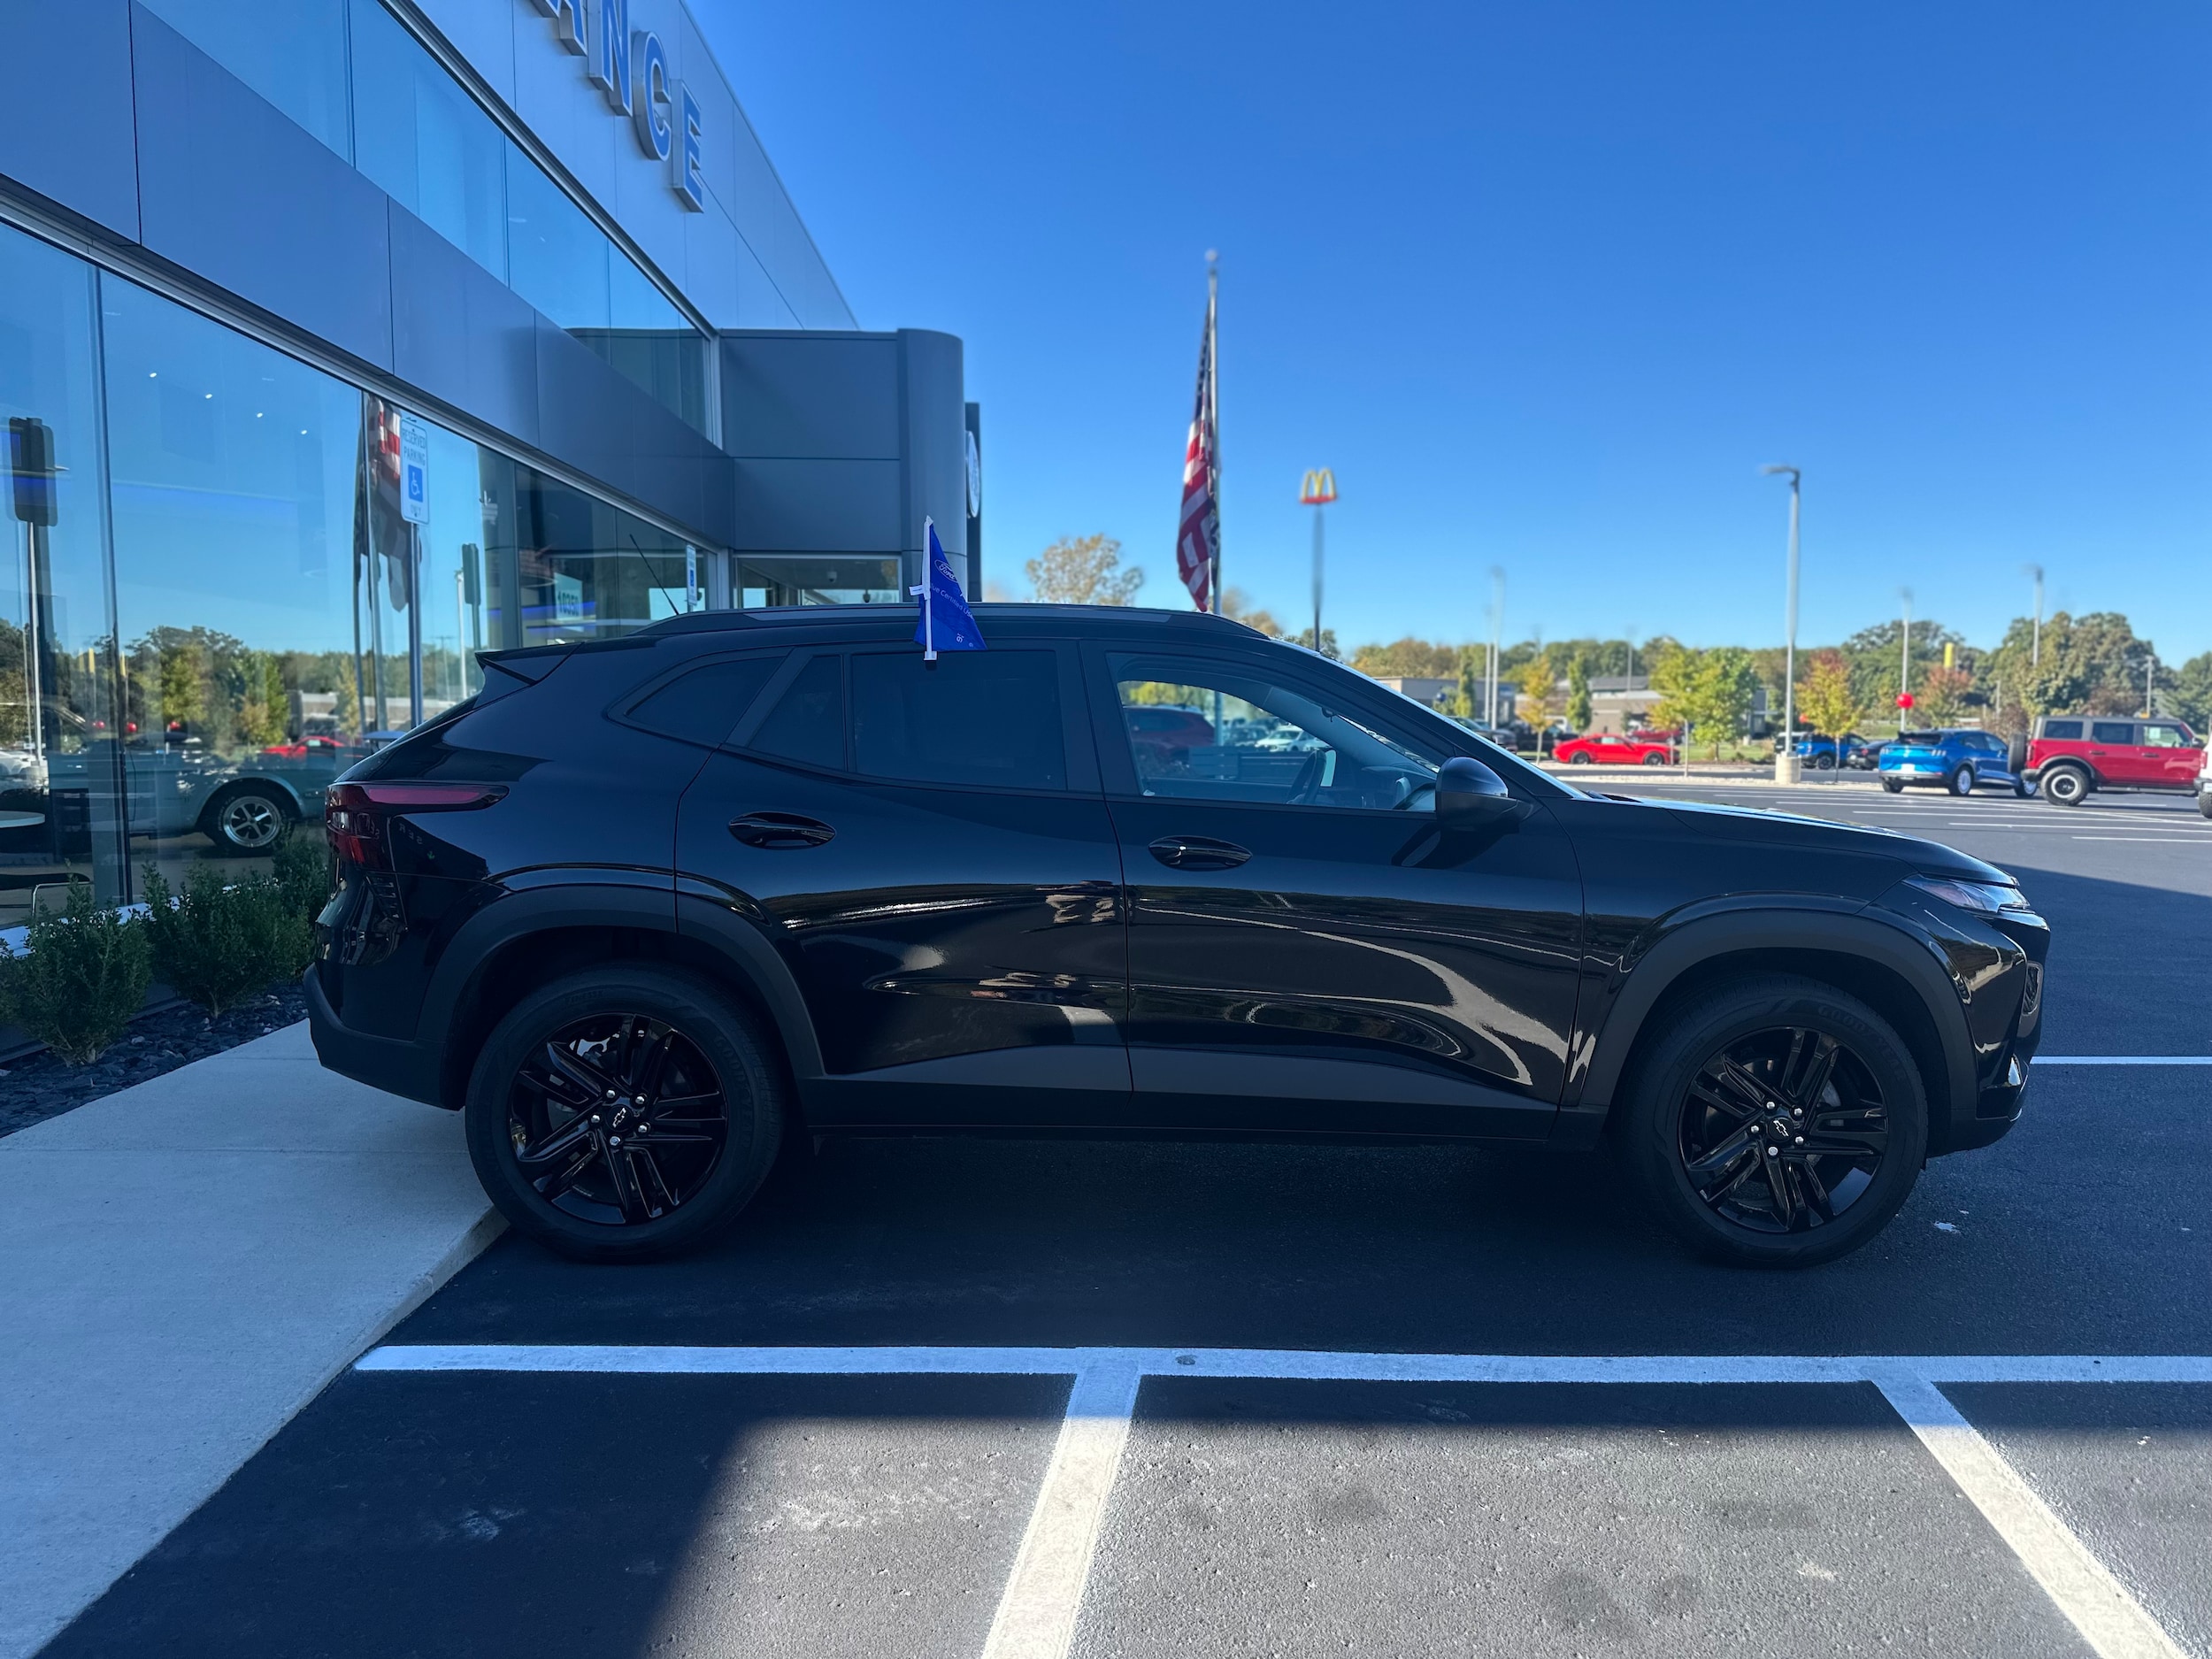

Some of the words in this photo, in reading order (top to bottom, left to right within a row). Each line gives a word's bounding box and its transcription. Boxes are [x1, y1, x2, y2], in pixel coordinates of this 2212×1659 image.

[402, 428, 426, 449] RESERVED
[403, 446, 425, 466] PARKING
[940, 589, 964, 611] Certified
